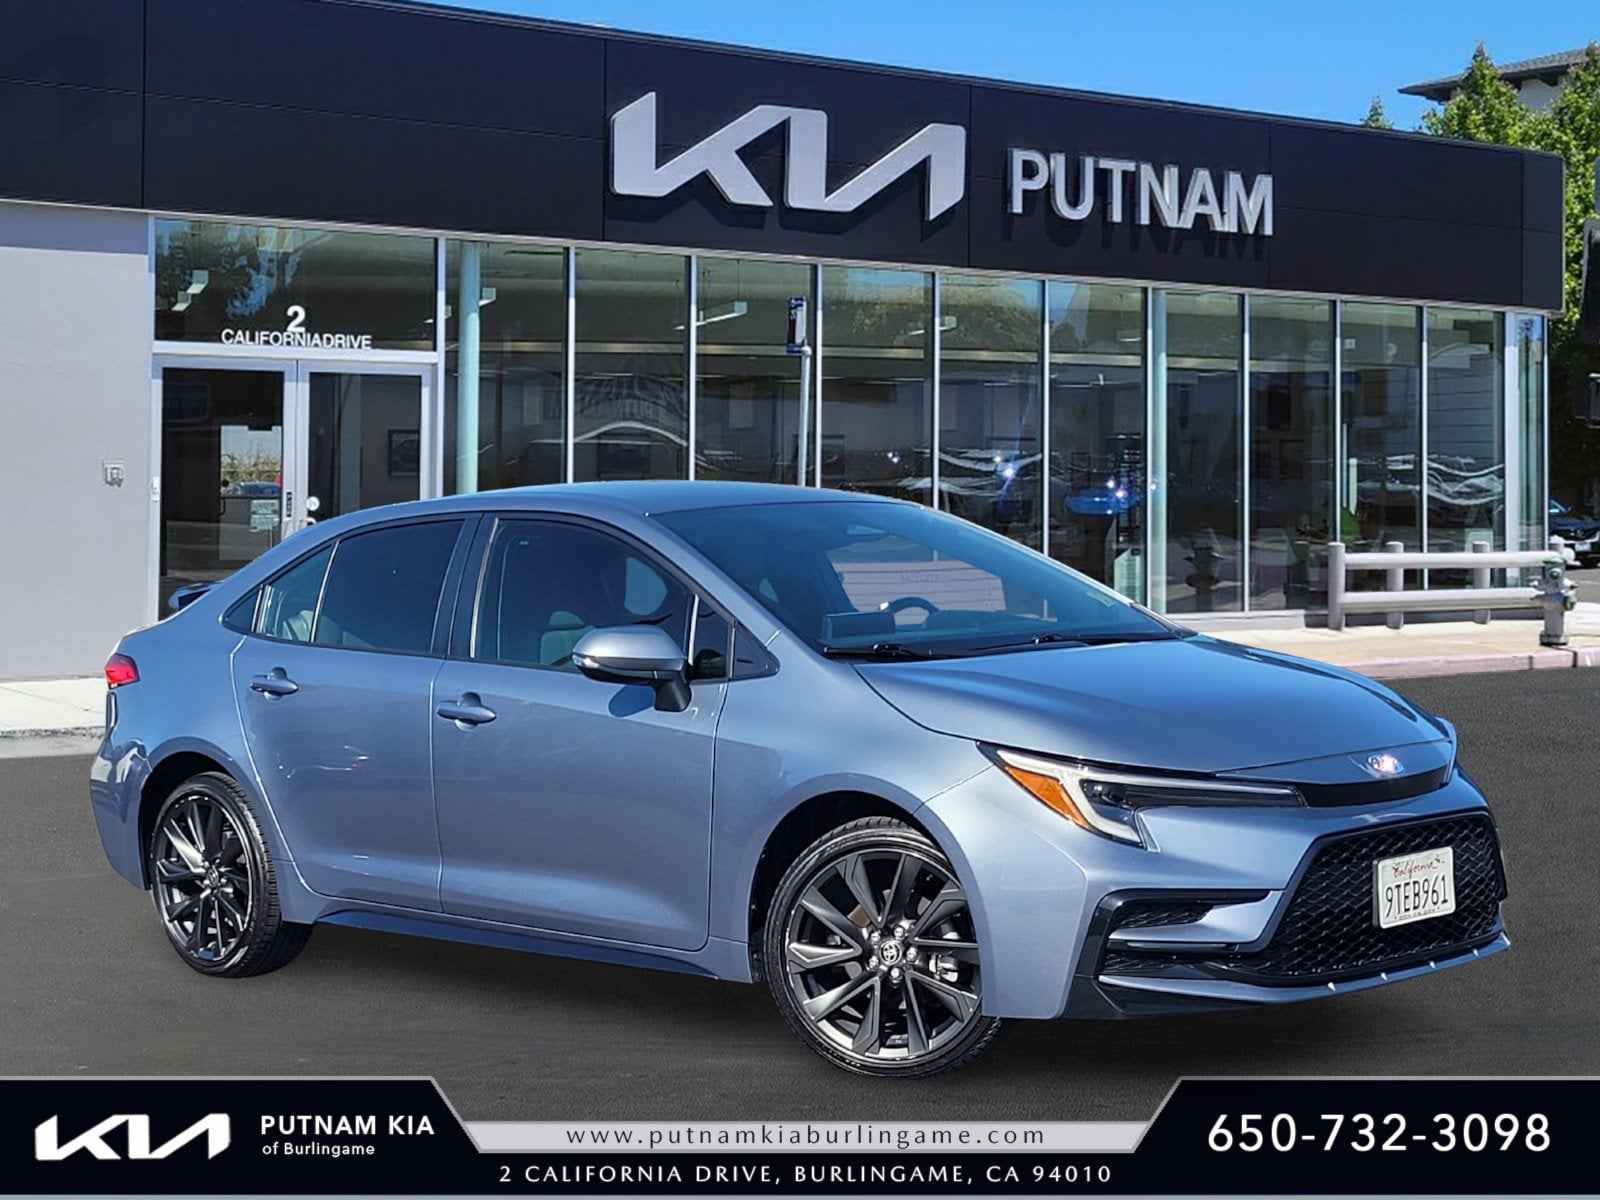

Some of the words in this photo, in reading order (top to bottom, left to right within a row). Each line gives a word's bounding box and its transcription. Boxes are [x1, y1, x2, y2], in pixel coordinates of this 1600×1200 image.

[611, 91, 967, 221] KIA
[1009, 148, 1274, 236] PUTNAM
[286, 305, 306, 333] 2
[1385, 873, 1448, 918] 9TEB961
